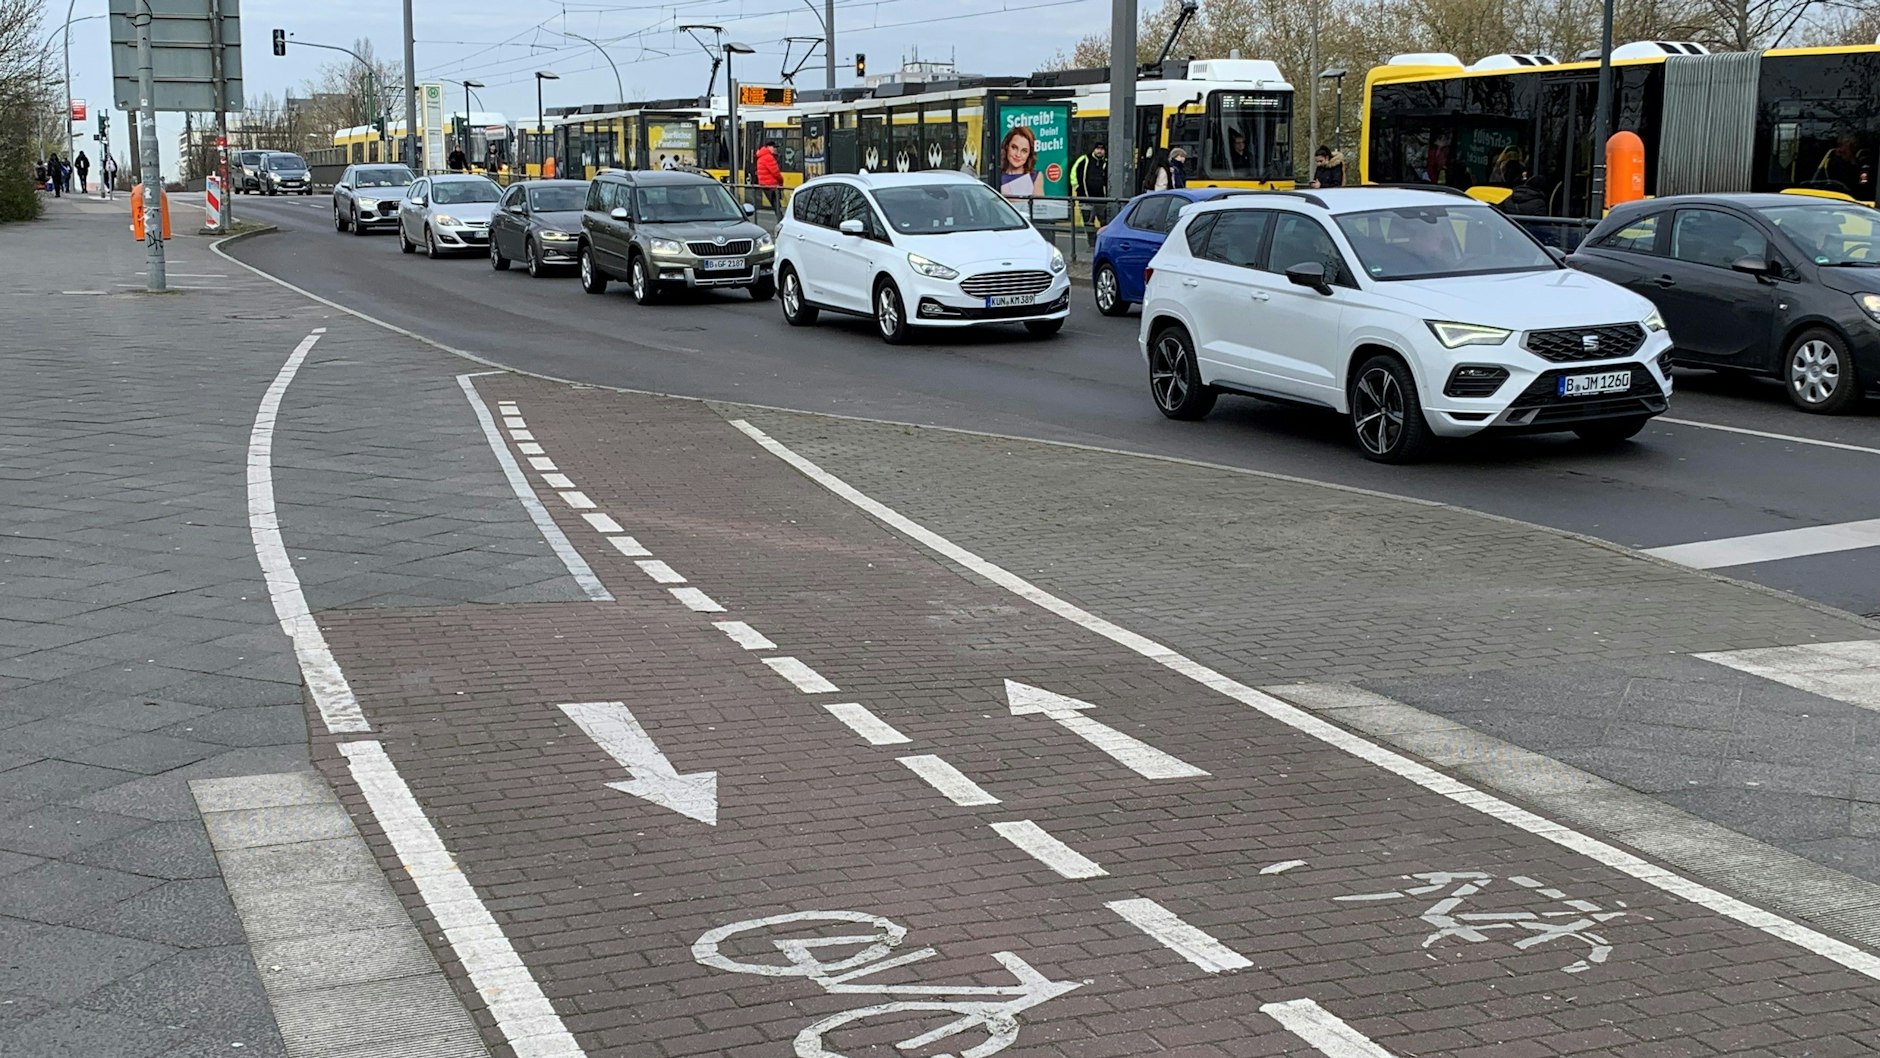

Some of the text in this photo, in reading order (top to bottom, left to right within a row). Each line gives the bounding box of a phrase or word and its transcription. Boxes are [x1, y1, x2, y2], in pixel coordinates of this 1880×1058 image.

[1006, 111, 1054, 128] Schreib!
[1039, 127, 1059, 137] Dein!
[1033, 138, 1064, 152] Buch!
[728, 259, 744, 267] 2187
[1010, 296, 1019, 304] KM
[1020, 295, 1034, 304] 389
[1582, 376, 1597, 390] JM
[1600, 374, 1629, 389] 1260
